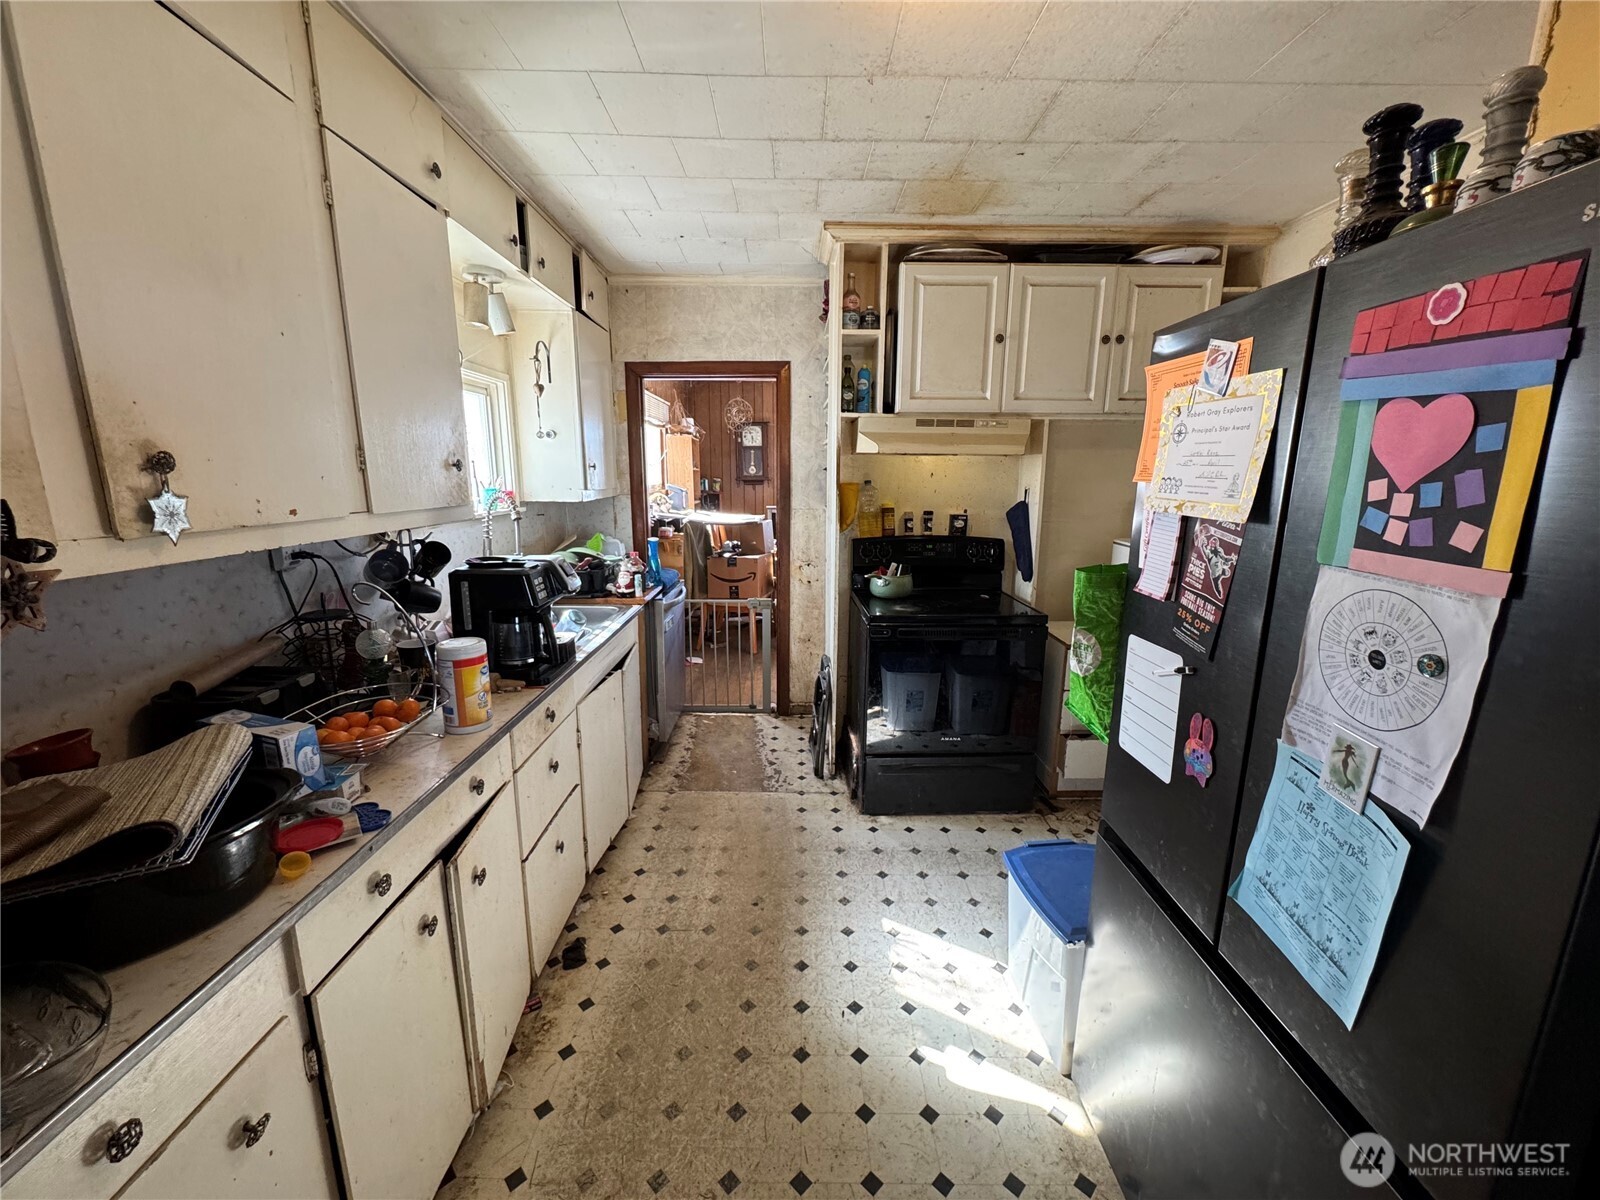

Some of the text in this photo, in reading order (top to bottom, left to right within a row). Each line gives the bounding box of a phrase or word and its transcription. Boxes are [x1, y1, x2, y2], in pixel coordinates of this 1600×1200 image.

[1186, 405, 1253, 418] Robert Gray Explorers
[1191, 426, 1218, 434] Principal's
[1232, 423, 1251, 431] Award
[1187, 563, 1206, 580] PIES
[1177, 608, 1211, 633] 25% OFF
[1323, 779, 1357, 806] MERMAZING
[1297, 800, 1320, 828] Happy
[1322, 822, 1345, 851] Spring
[1345, 843, 1370, 870] Break
